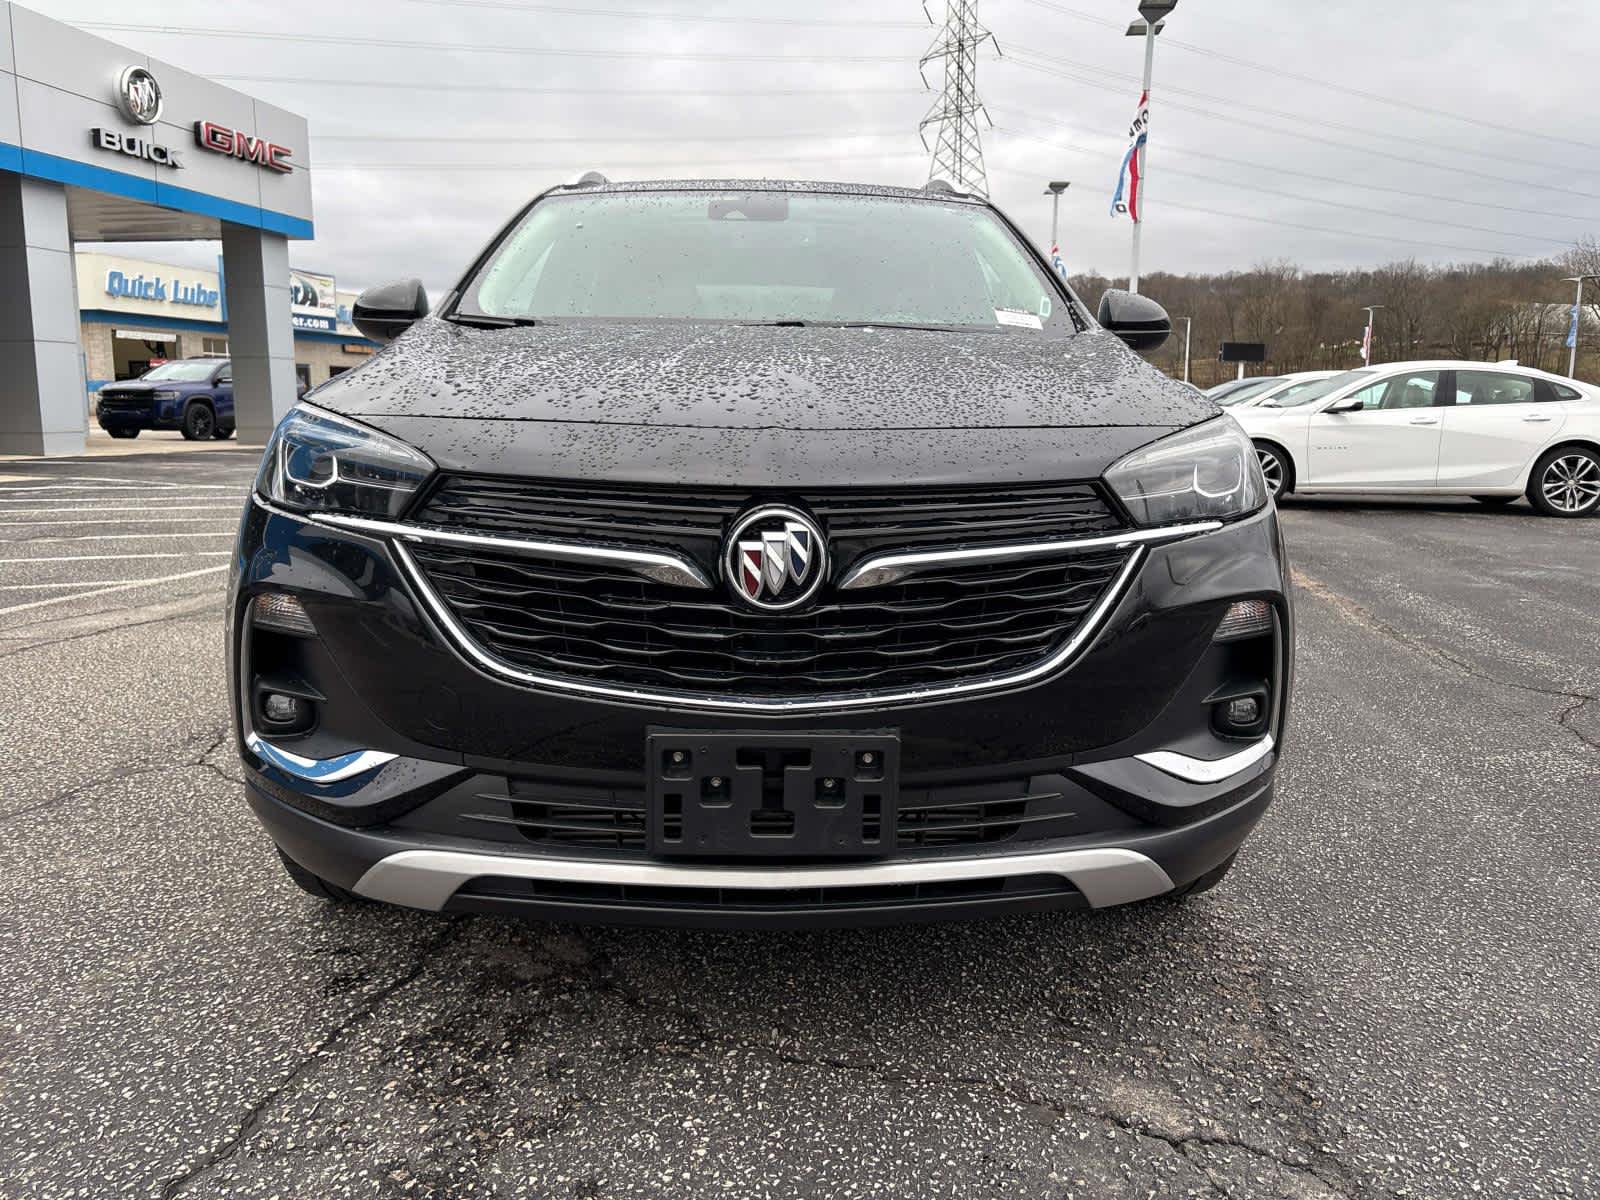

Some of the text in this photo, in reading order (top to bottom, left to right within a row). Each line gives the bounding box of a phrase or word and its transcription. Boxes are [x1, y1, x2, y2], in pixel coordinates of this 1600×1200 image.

[93, 127, 183, 169] BUICK
[195, 120, 293, 174] GMC
[106, 271, 219, 307] Quick Lube
